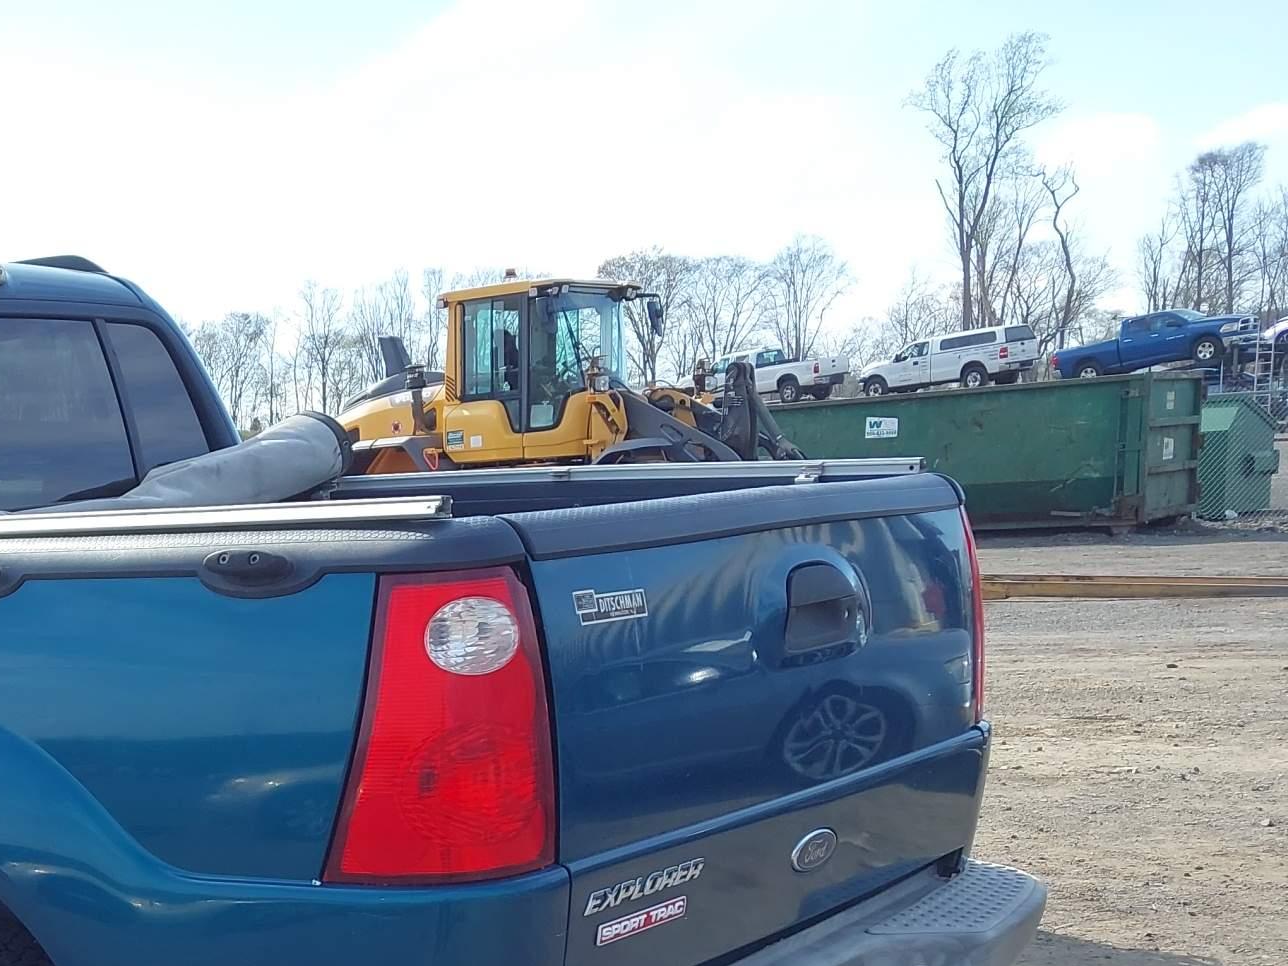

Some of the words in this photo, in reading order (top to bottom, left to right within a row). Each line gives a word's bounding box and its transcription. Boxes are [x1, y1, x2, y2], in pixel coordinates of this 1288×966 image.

[583, 857, 705, 917] EXPLORER
[601, 914, 647, 940] SPORT
[649, 901, 684, 923] TRAC
